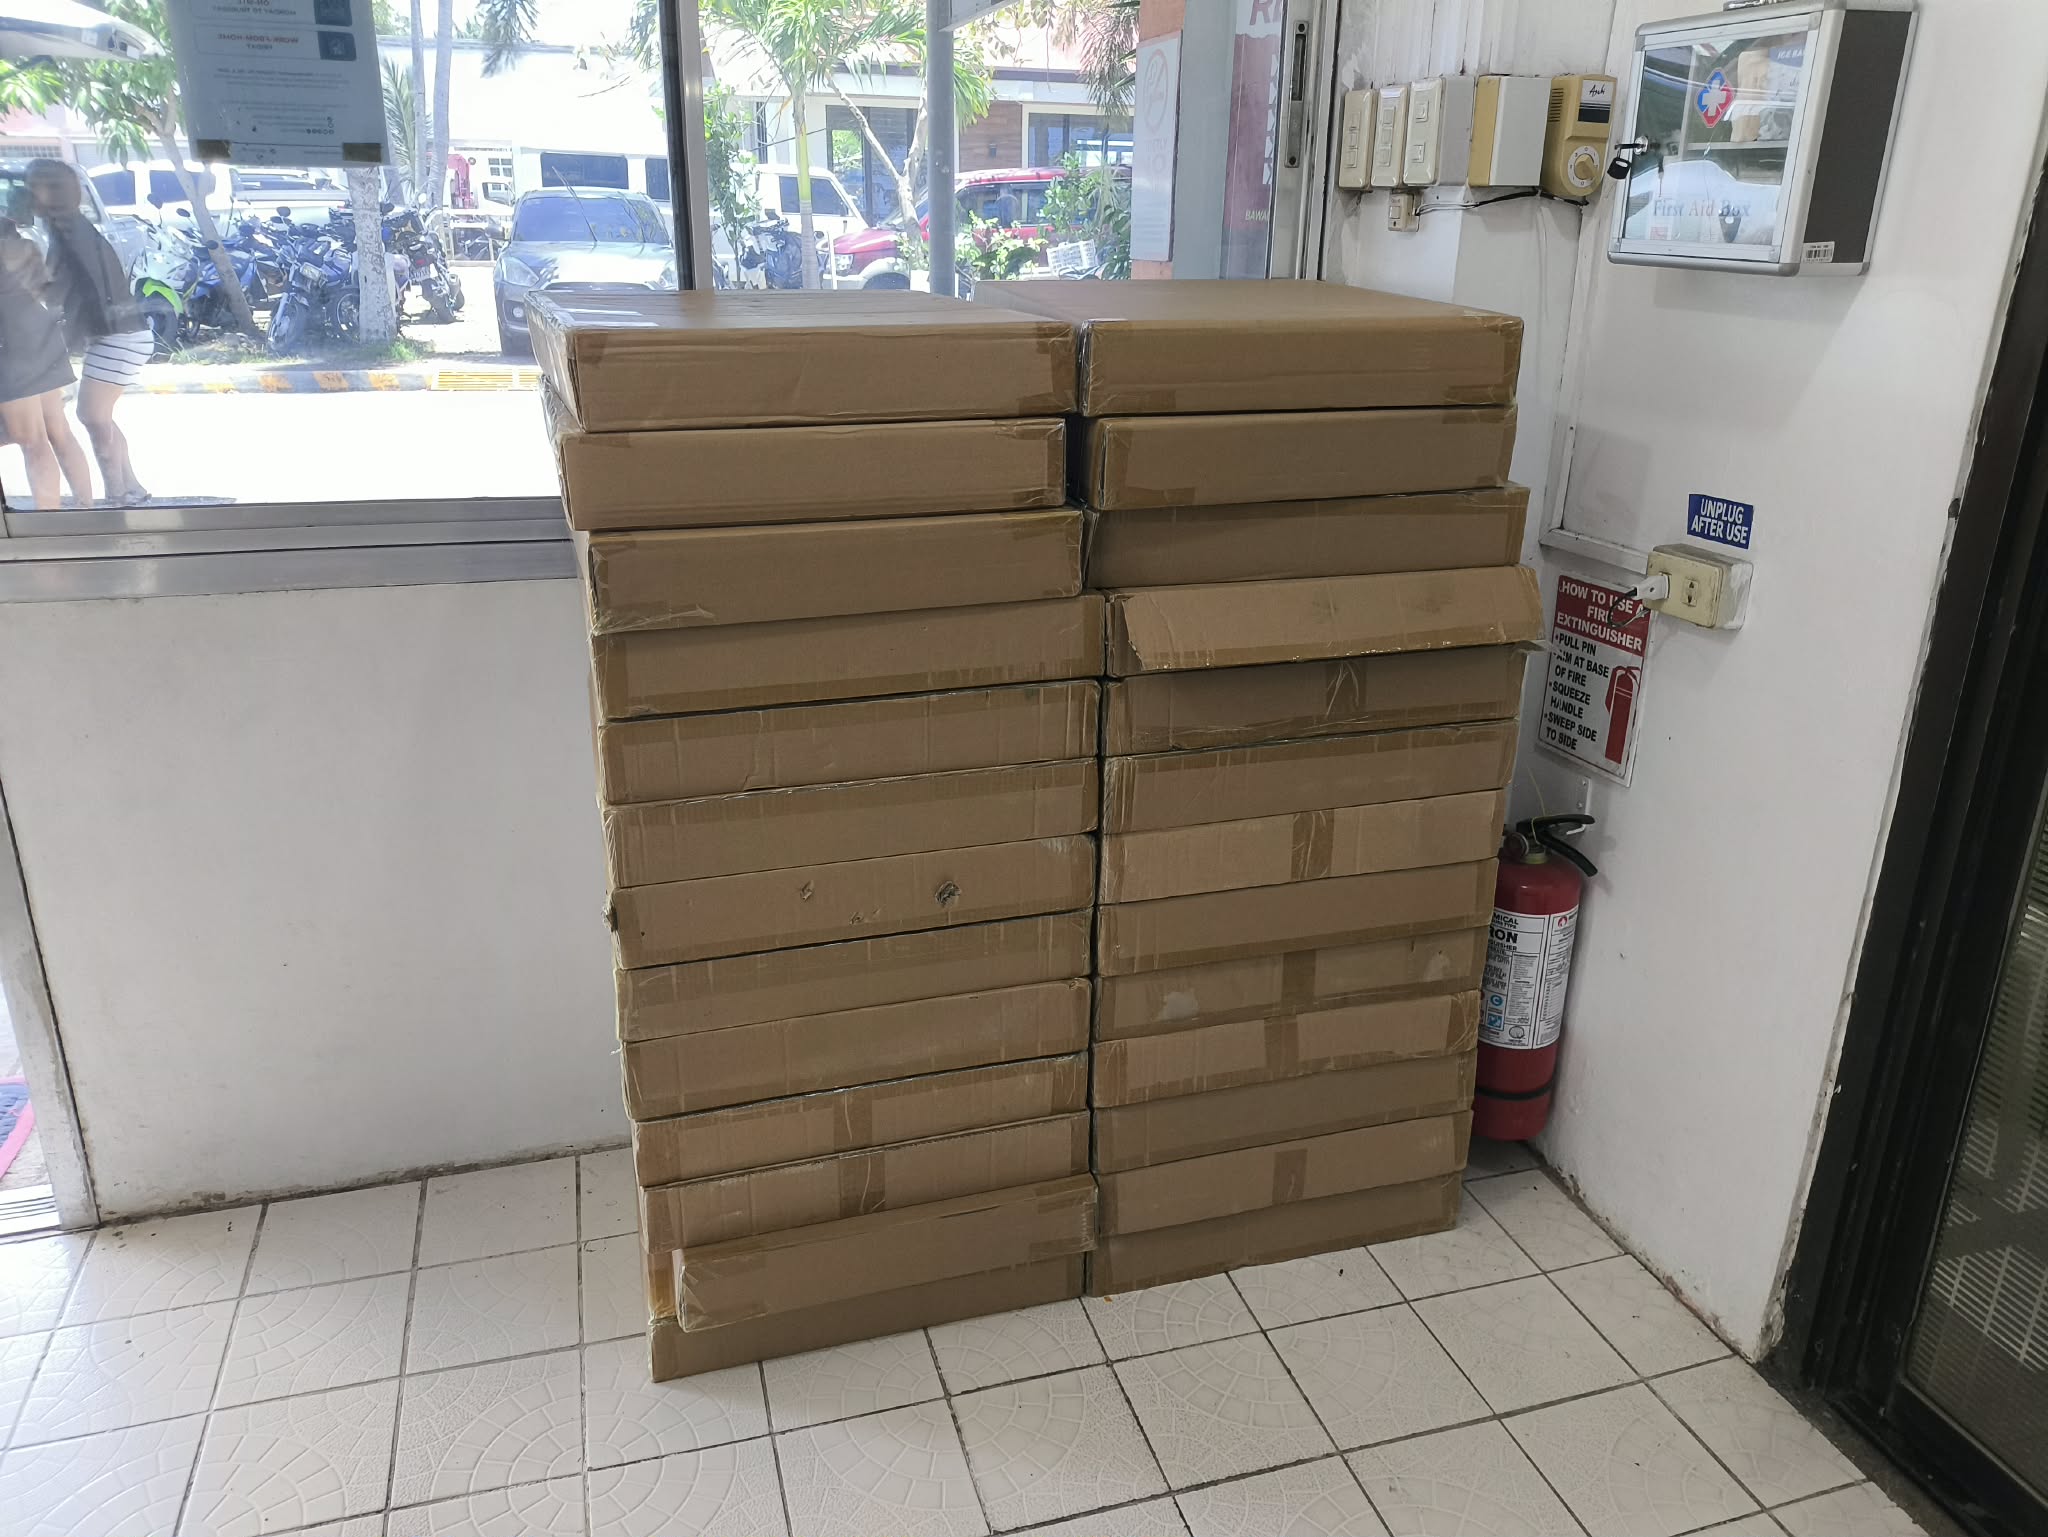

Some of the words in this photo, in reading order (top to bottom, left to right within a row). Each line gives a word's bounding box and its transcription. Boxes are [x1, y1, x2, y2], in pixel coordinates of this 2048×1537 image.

[1653, 199, 1685, 217] First
[1688, 199, 1715, 217] Aid
[1718, 199, 1751, 217] Box
[1700, 498, 1744, 524] UNPLUG
[1690, 514, 1724, 539] AFTER
[1726, 522, 1749, 544] USE
[1561, 580, 1589, 599] HOW
[1591, 589, 1607, 605] TO
[1557, 611, 1643, 652] EXTINGUISHER
[1559, 632, 1580, 650] PULL
[1581, 640, 1597, 656] PIN
[1555, 664, 1567, 678] OF
[1567, 669, 1587, 687] FIRE
[1573, 655, 1586, 669] AT
[1586, 659, 1610, 678] BASE
[1552, 681, 1591, 706] SQUEEZE
[1550, 695, 1584, 719] HANDLE
[1546, 726, 1557, 740] TO
[1558, 732, 1578, 751] SIDE
[1547, 711, 1576, 732] SWEEP
[1577, 724, 1598, 742] SIDE
